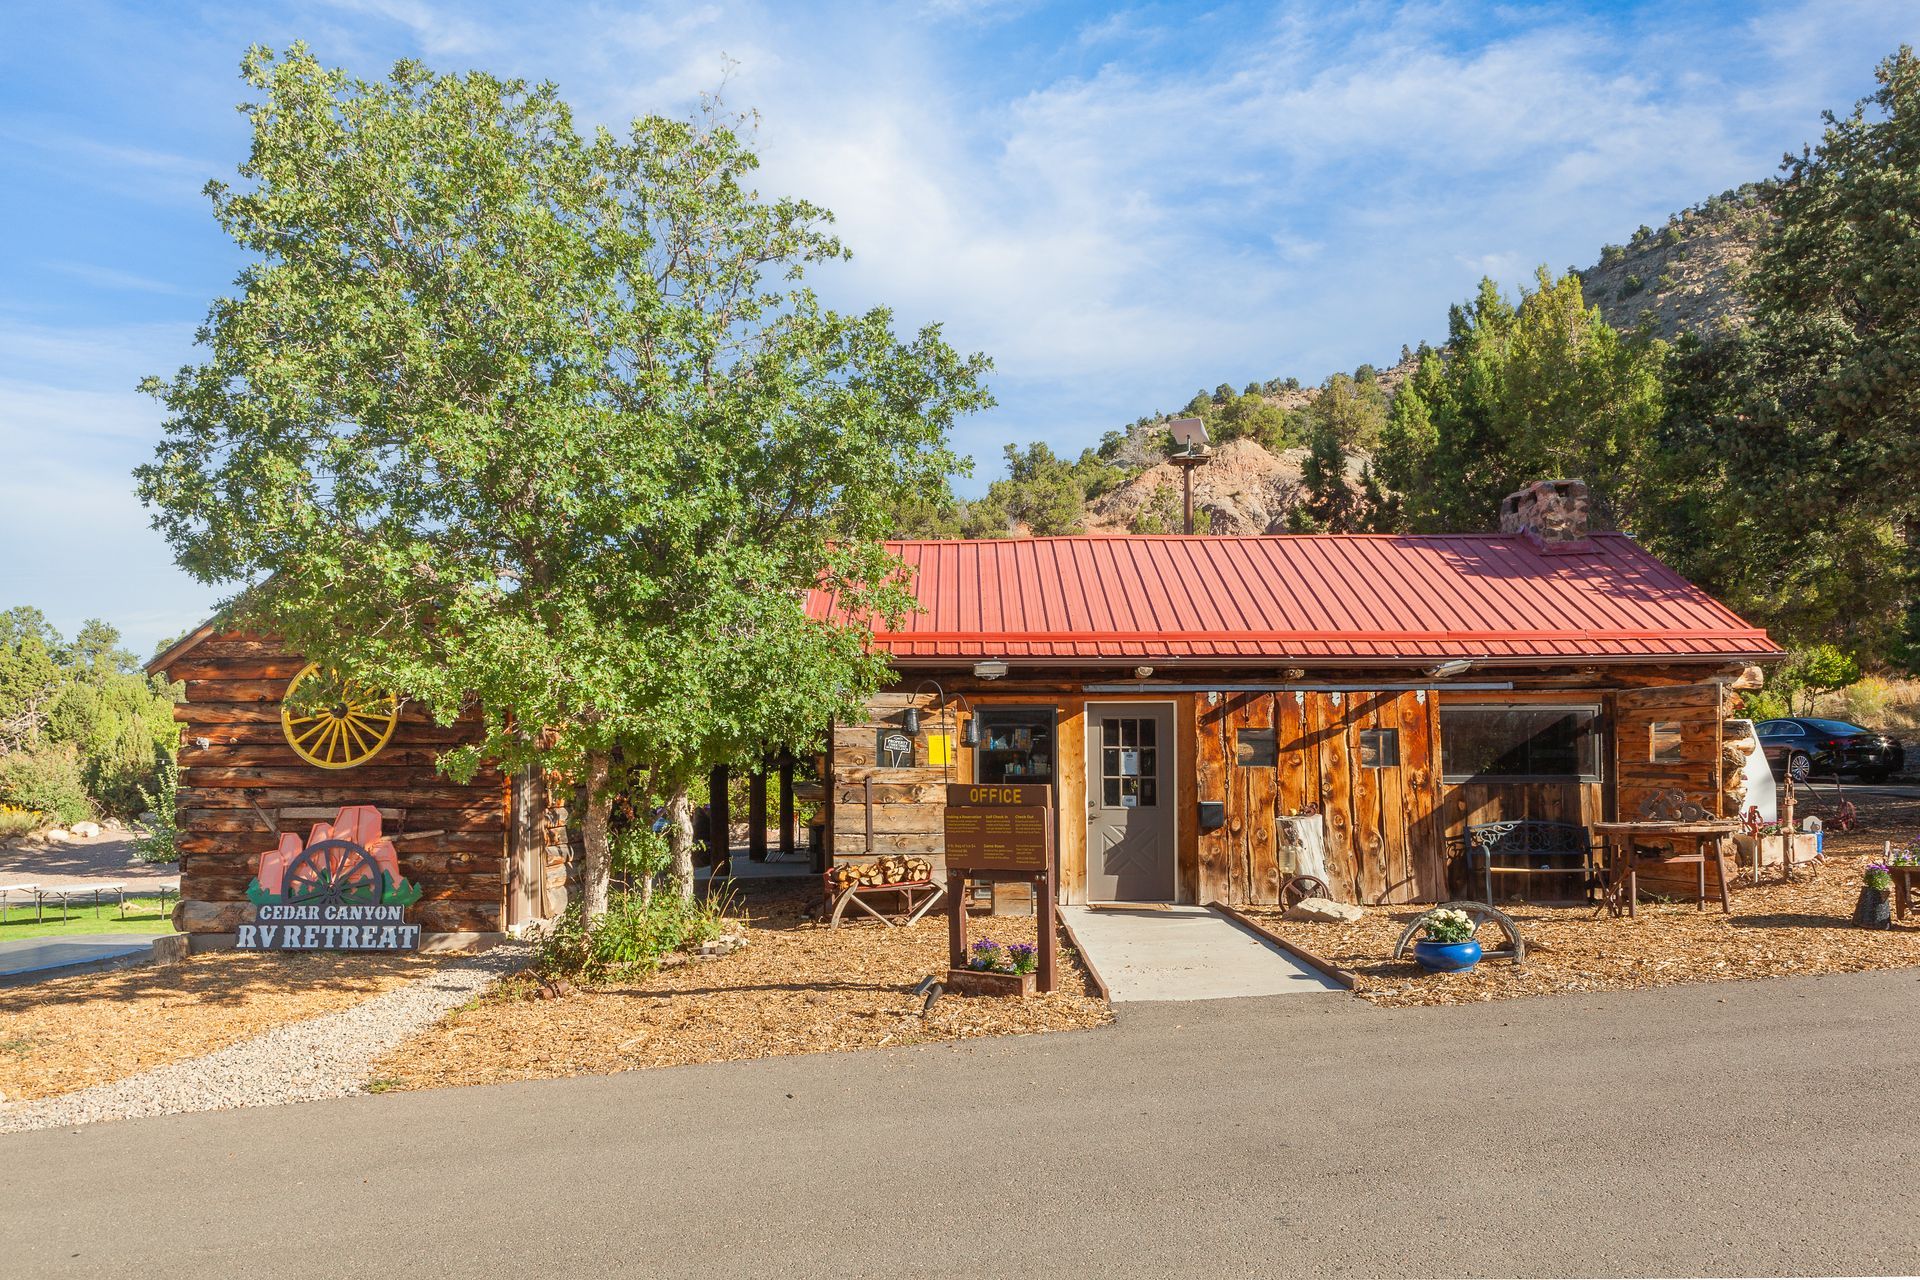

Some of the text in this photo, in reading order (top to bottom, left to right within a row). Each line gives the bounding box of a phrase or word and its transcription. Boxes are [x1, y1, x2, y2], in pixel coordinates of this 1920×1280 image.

[970, 789, 1022, 803] OFFICE
[259, 905, 402, 920] CEDAR CANYON
[236, 925, 418, 949] RV RETREAT
